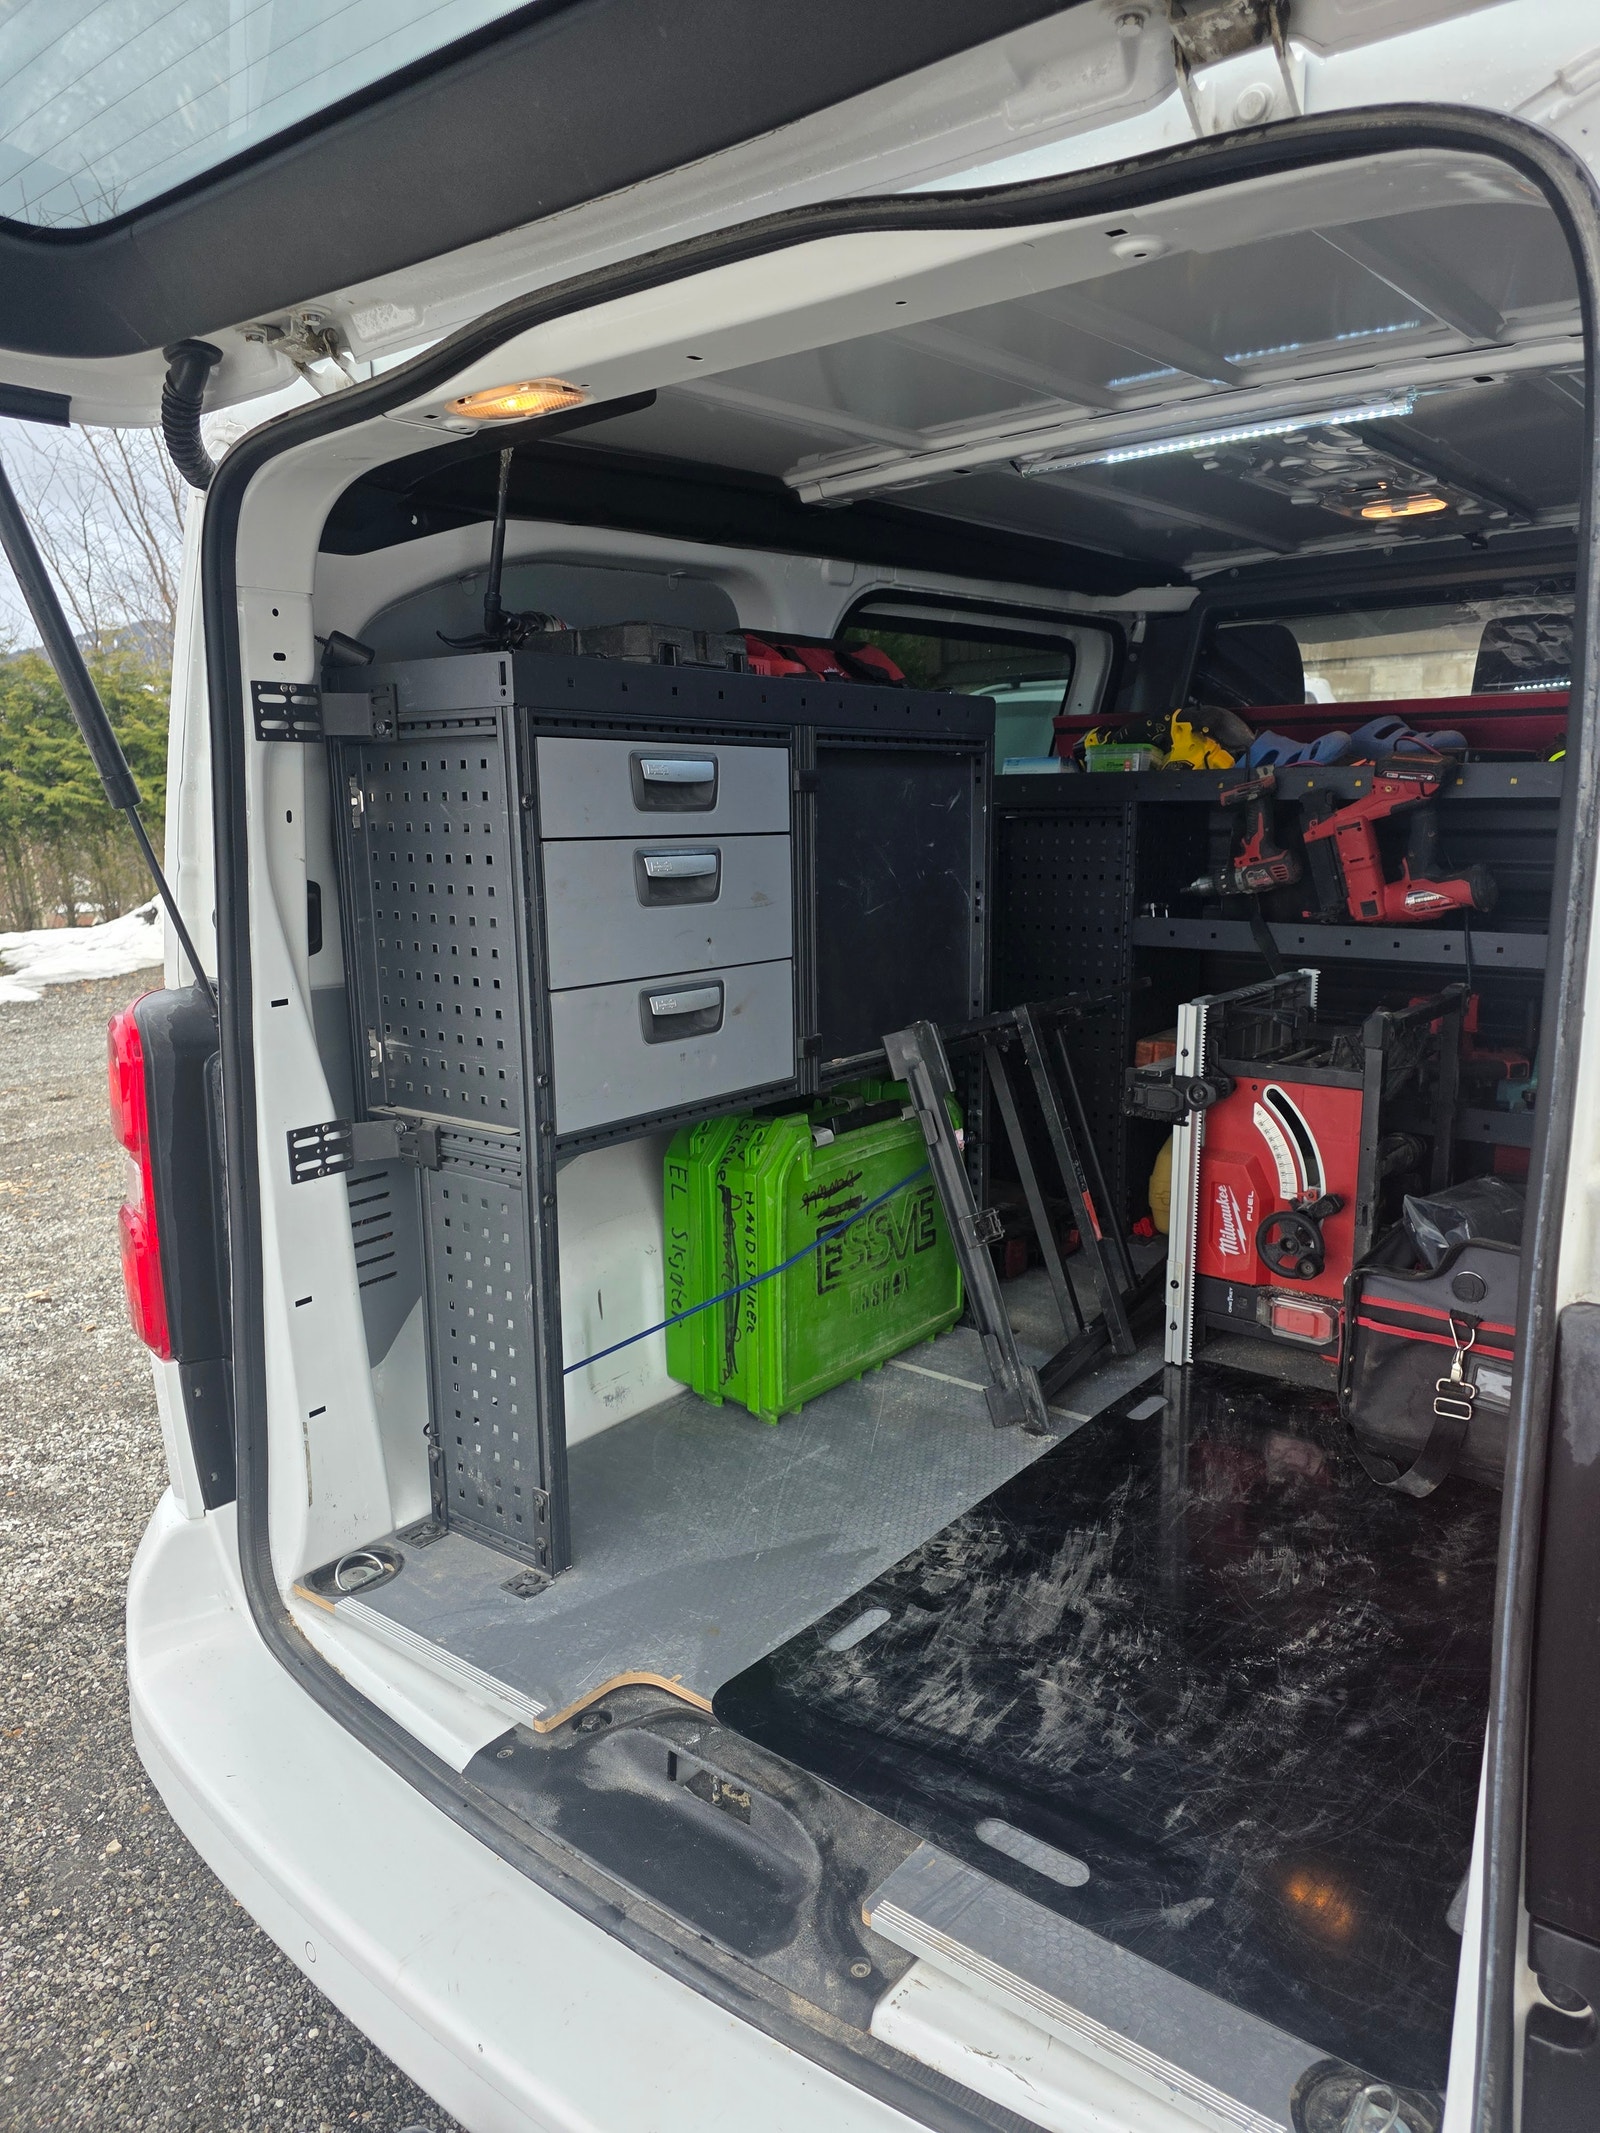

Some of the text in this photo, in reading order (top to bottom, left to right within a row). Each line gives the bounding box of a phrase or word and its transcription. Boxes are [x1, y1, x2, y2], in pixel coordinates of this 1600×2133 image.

[669, 1164, 689, 1200] EL
[1246, 1190, 1254, 1222] FUEL
[816, 1185, 937, 1295] ESSVE
[1216, 1184, 1240, 1257] Milwaukee
